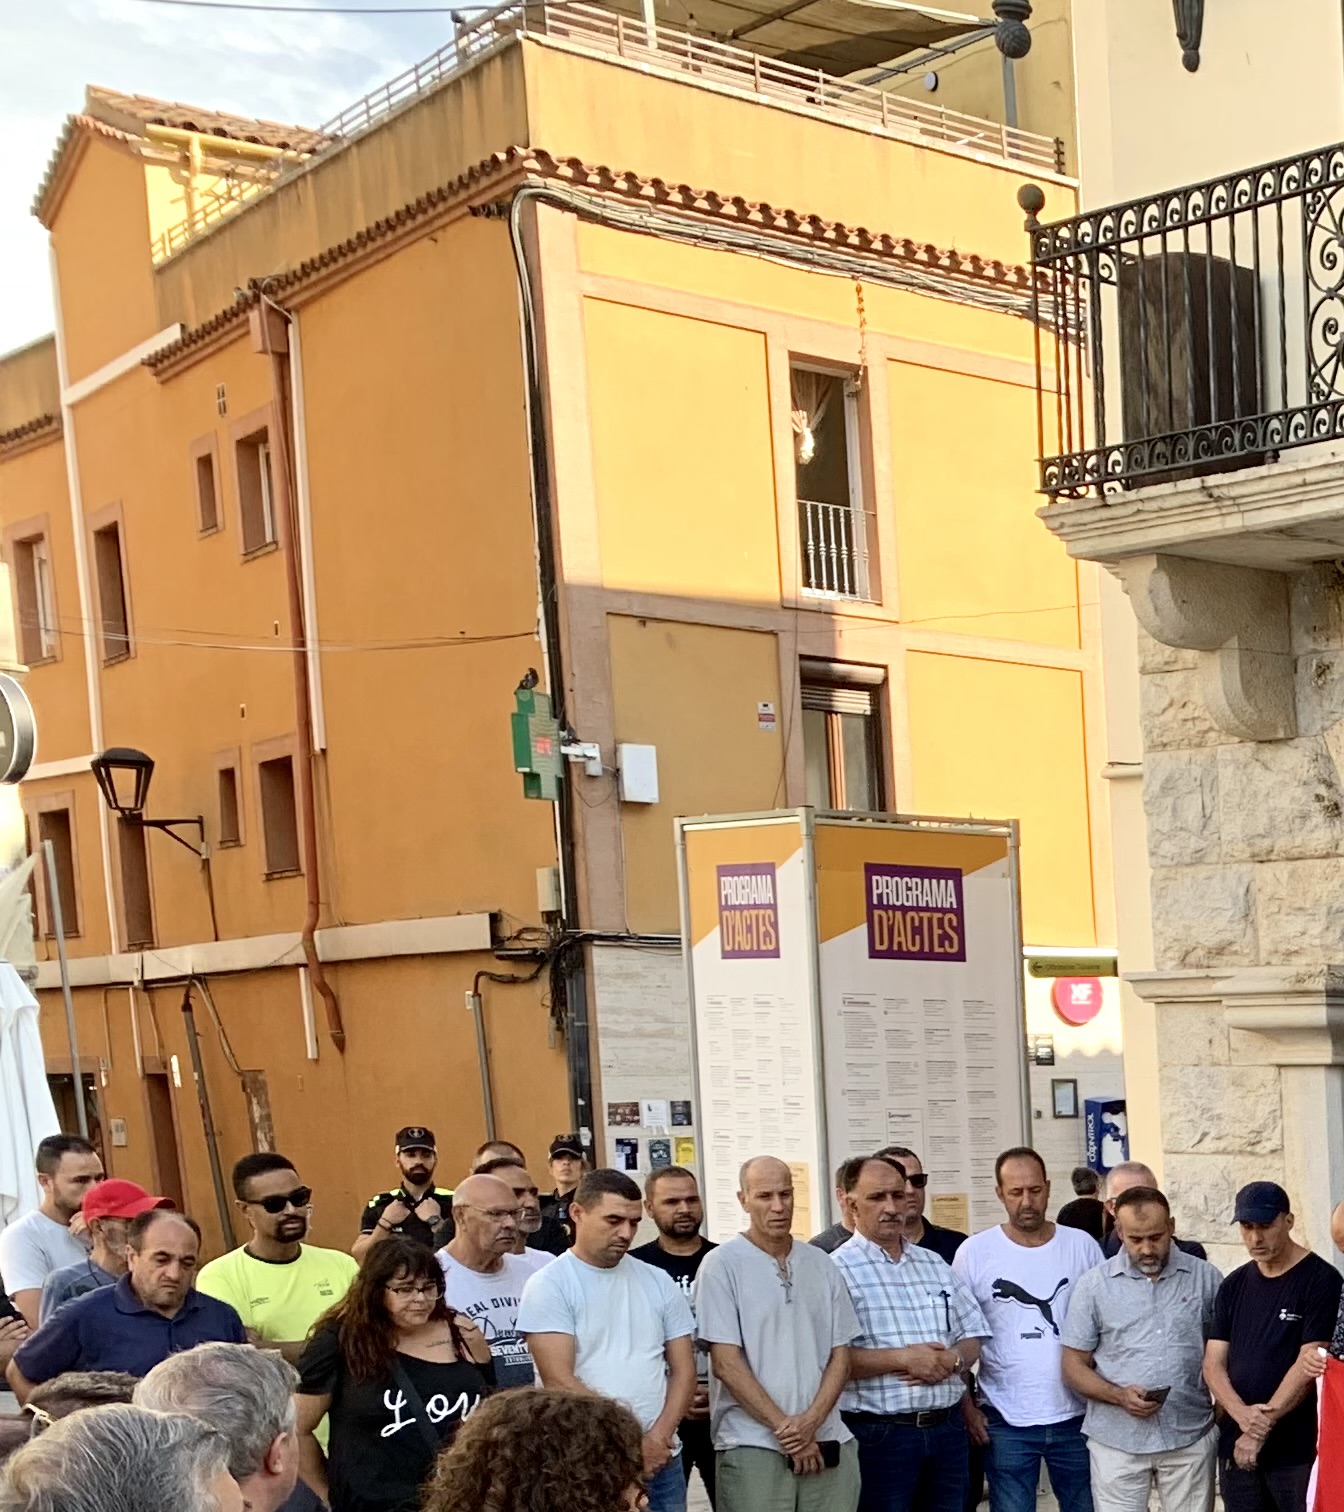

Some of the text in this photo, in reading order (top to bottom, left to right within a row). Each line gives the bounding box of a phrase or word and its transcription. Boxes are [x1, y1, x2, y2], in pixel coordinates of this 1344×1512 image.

[720, 874, 774, 906] PROGRAMA
[871, 875, 957, 909] PROGRAMA
[722, 909, 776, 952] D'ACTES
[873, 909, 958, 953] D'ACTES
[465, 1296, 521, 1317] EAL DIVI
